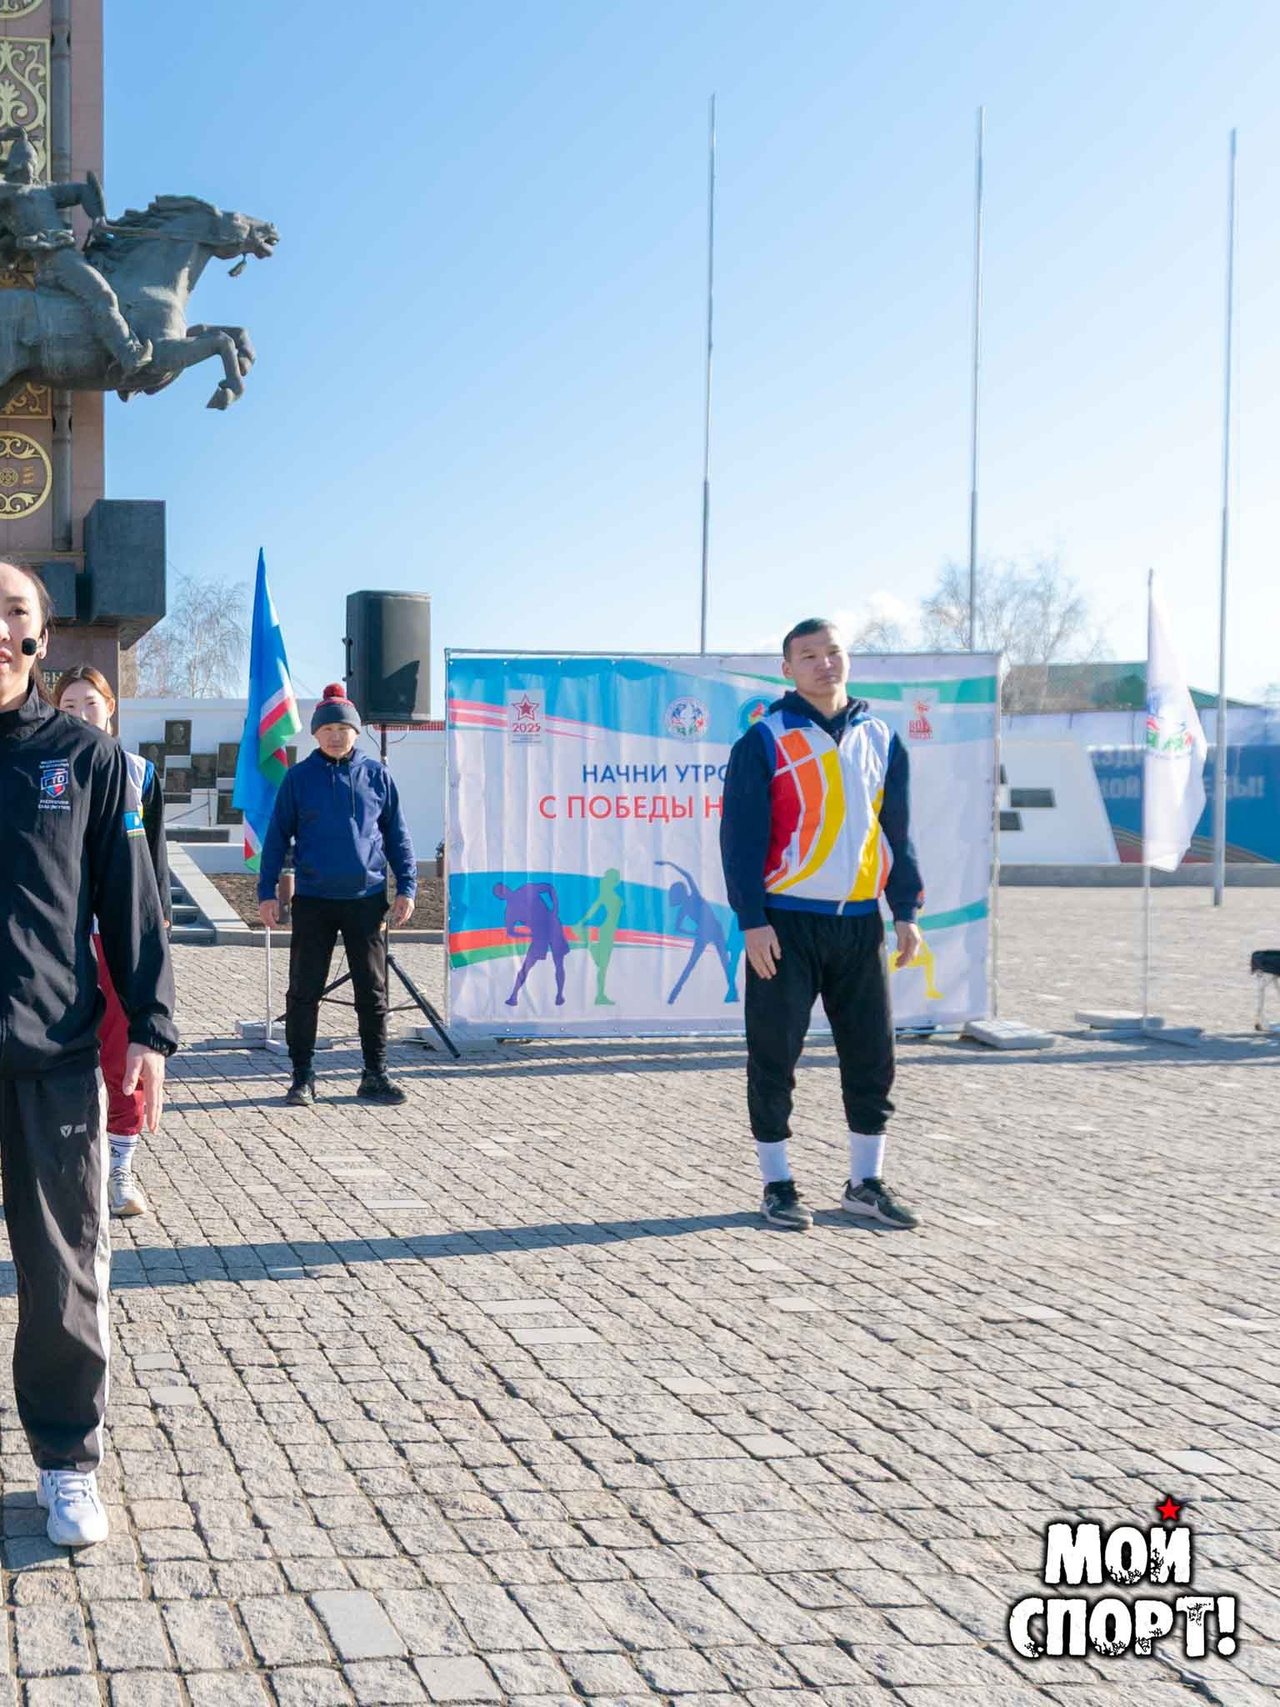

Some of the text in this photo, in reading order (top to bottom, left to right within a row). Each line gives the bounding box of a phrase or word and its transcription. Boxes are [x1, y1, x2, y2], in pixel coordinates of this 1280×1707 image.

[582, 764, 668, 784] НАЧНИ
[538, 795, 558, 819] С
[567, 795, 694, 823] ПОБЕДЫ
